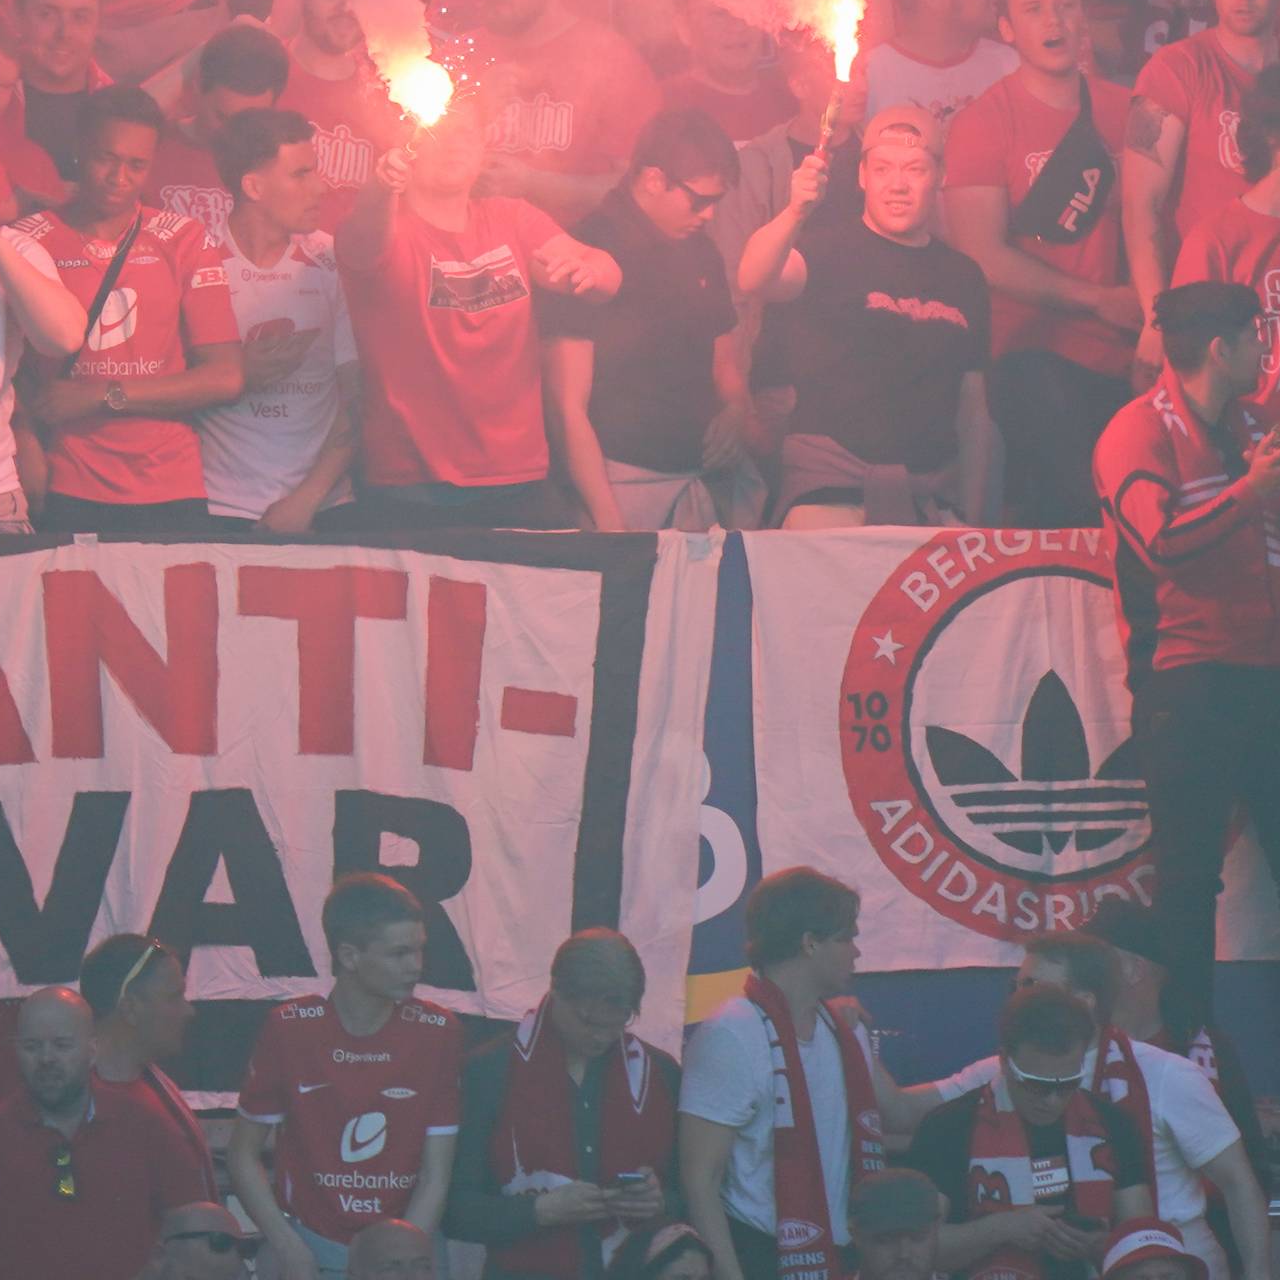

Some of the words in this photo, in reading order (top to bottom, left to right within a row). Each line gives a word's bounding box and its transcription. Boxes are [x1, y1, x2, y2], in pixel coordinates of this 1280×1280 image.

[1058, 167, 1100, 232] FILA
[249, 401, 289, 420] Vest
[847, 691, 889, 720] 10
[852, 725, 893, 753] 70
[299, 1005, 326, 1019] BOB
[339, 1194, 383, 1214] Vest
